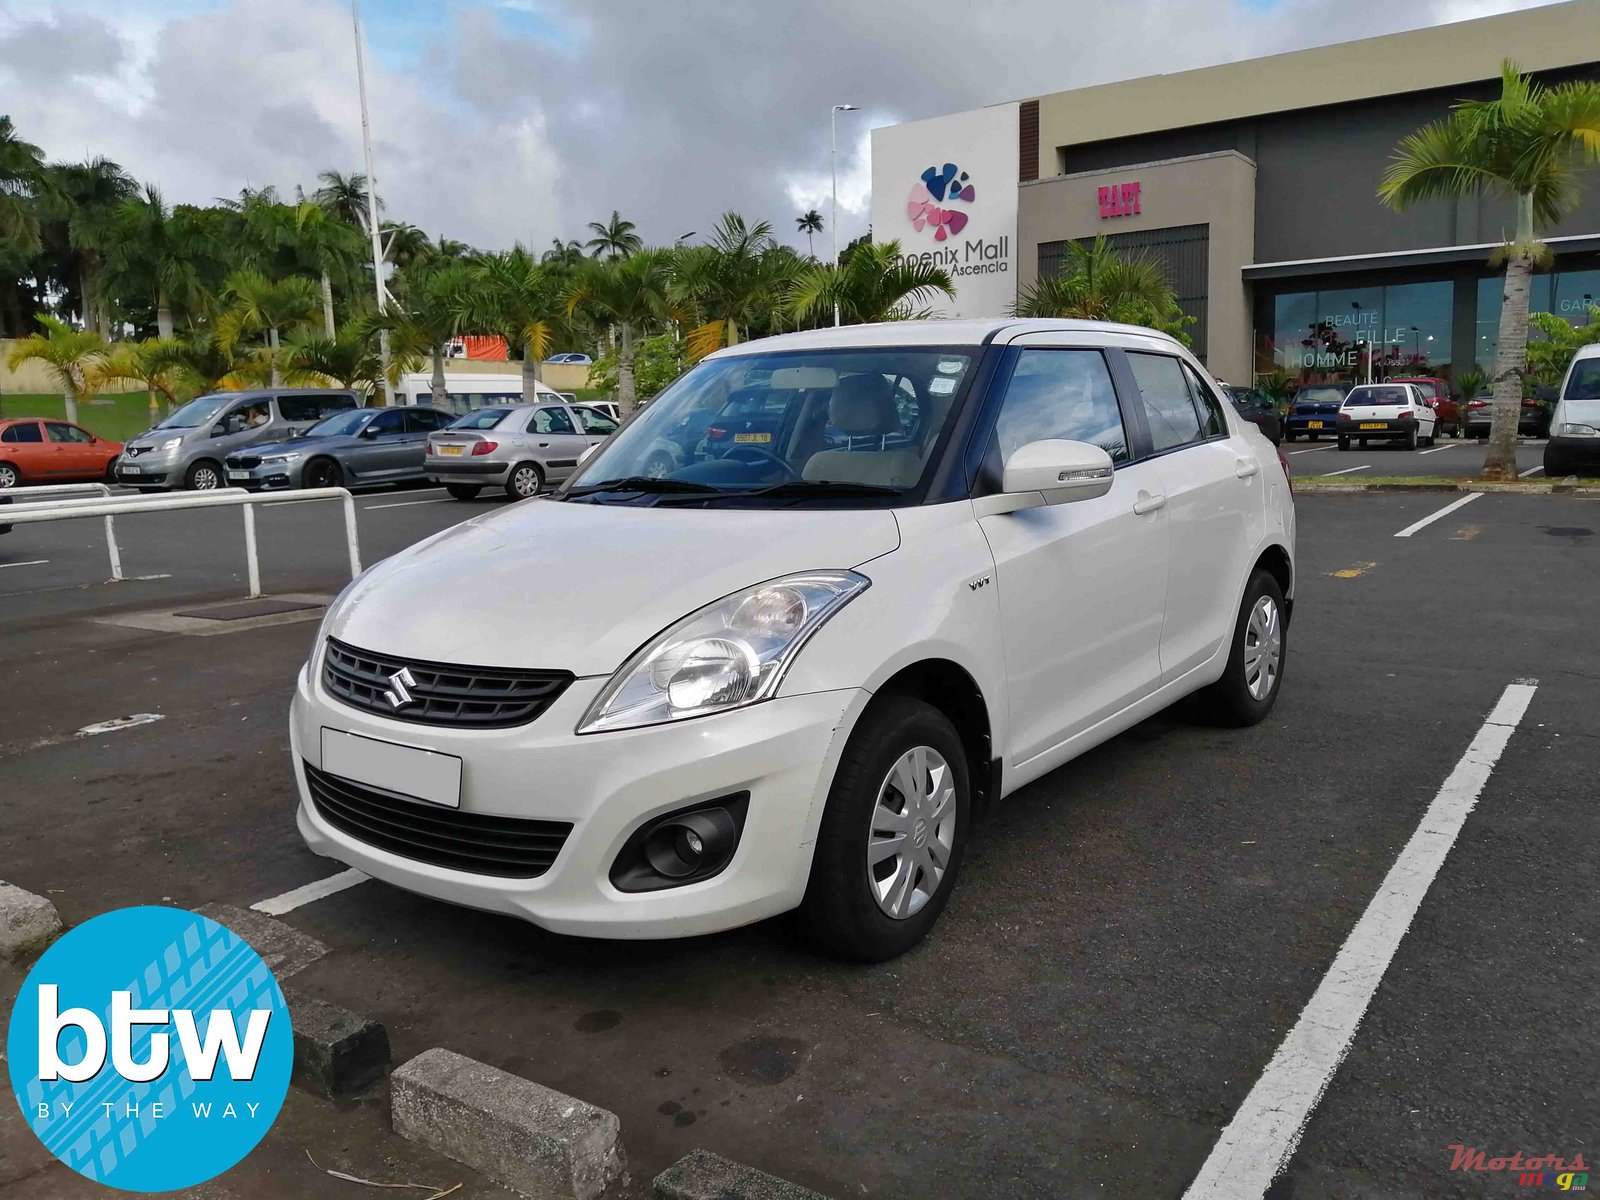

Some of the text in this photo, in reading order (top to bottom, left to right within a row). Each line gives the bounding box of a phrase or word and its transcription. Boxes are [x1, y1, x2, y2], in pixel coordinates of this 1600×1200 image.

[1098, 182, 1141, 219] TATI
[965, 235, 1008, 262] Mall
[950, 260, 1008, 277] Ascencia
[1325, 310, 1379, 328] BEAUTÉ
[1356, 327, 1406, 345] FILLE
[1291, 350, 1358, 369] HOMME
